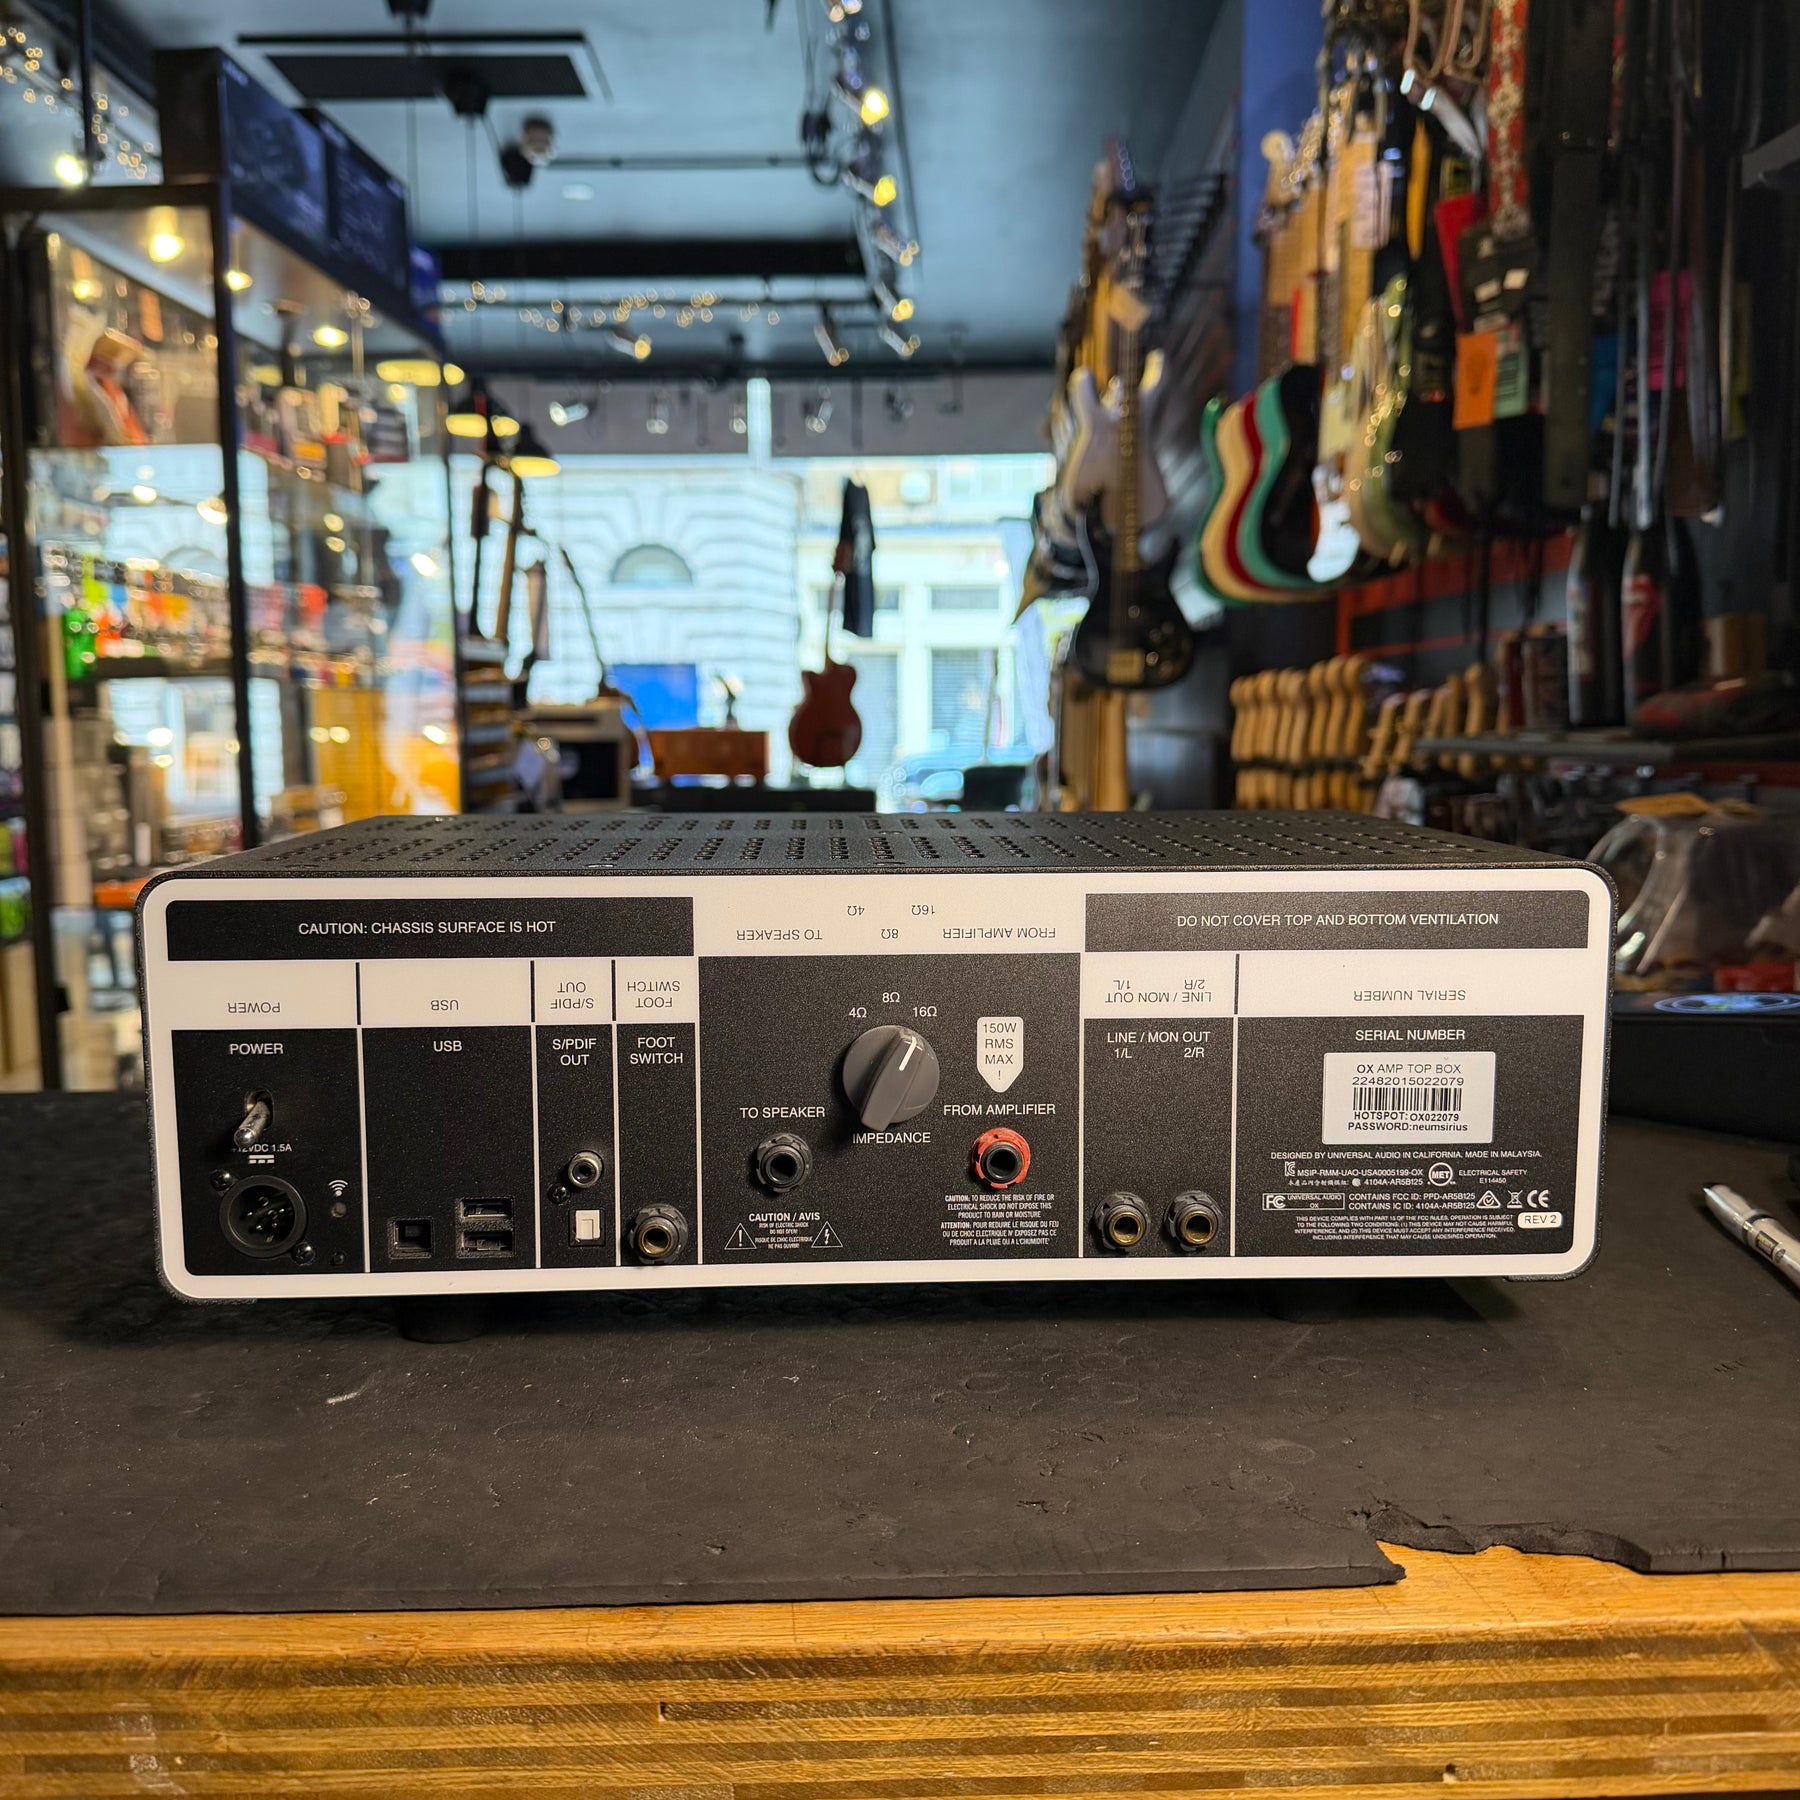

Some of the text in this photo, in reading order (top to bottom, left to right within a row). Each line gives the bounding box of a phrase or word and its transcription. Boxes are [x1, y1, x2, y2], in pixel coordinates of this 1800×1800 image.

[1177, 914, 1499, 927] DO NOT COVER TOP AND BOTTOM VENTILATION
[299, 921, 556, 935] CAUTION: CHASSIS SURFACE IS HOT
[943, 927, 1056, 939] FROM AMPLIFIER
[736, 929, 823, 941] TO SPEAKER
[557, 982, 586, 993] OUT
[627, 980, 680, 992] SWITCH
[1113, 980, 1131, 990] 1/L
[1184, 979, 1205, 990] 2/R
[882, 992, 900, 1003] 8Ω
[1105, 991, 1211, 1003] LINE / MON OUT
[1353, 990, 1466, 1001] SERIAL NUMBER
[227, 1002, 281, 1014] POWER
[430, 999, 459, 1011] USB
[550, 998, 594, 1009] S/PDIF
[635, 997, 673, 1008] FOOT
[848, 1007, 867, 1018] 4Ω
[912, 1006, 938, 1017] 16Ω
[982, 1022, 1017, 1033] 150W
[1107, 1031, 1211, 1043] LINE / MON OUT
[1355, 1029, 1466, 1041] SERIAL NUMBER
[433, 1040, 463, 1052] USB
[552, 1038, 597, 1050] S/PDIF
[637, 1037, 675, 1048] FOOT
[984, 1038, 1014, 1049] RMS
[229, 1043, 284, 1055] POWER
[1114, 1047, 1132, 1059] 1/L
[1184, 1047, 1205, 1058] 2/R
[560, 1054, 589, 1066] OUT
[629, 1053, 684, 1064] SWITCH
[984, 1054, 1014, 1065] MAX
[1357, 1064, 1461, 1074] OX AMP TOP BOX
[998, 1070, 1001, 1081] !
[1352, 1076, 1464, 1087] 22482015022079
[740, 1106, 825, 1119] TO SPEAKER
[943, 1103, 1056, 1116] FROM AMPLIFIER
[1354, 1111, 1459, 1122] HOTSPOT: OX022079
[852, 1132, 931, 1144] IMPEDANCE
[271, 1143, 292, 1152] 1.5A
[1327, 1151, 1373, 1159] UNIVERSAL
[1375, 1151, 1401, 1159] AUDIO
[1402, 1151, 1411, 1159] IN
[1412, 1151, 1463, 1159] CALIFORNIA.
[1500, 1150, 1542, 1158] MALAYSIA.
[1431, 1170, 1450, 1179] MET
[1364, 1178, 1423, 1186] 4104A-AR5B125
[1348, 1193, 1391, 1201] CONTAINS
[1423, 1192, 1476, 1200] PPD-AR5B125
[1348, 1202, 1476, 1210] CONTAINS IC ID: 4104A-AR5B125
[748, 1212, 821, 1222] CAUTION / AVIS
[1524, 1214, 1557, 1224] REV 2
